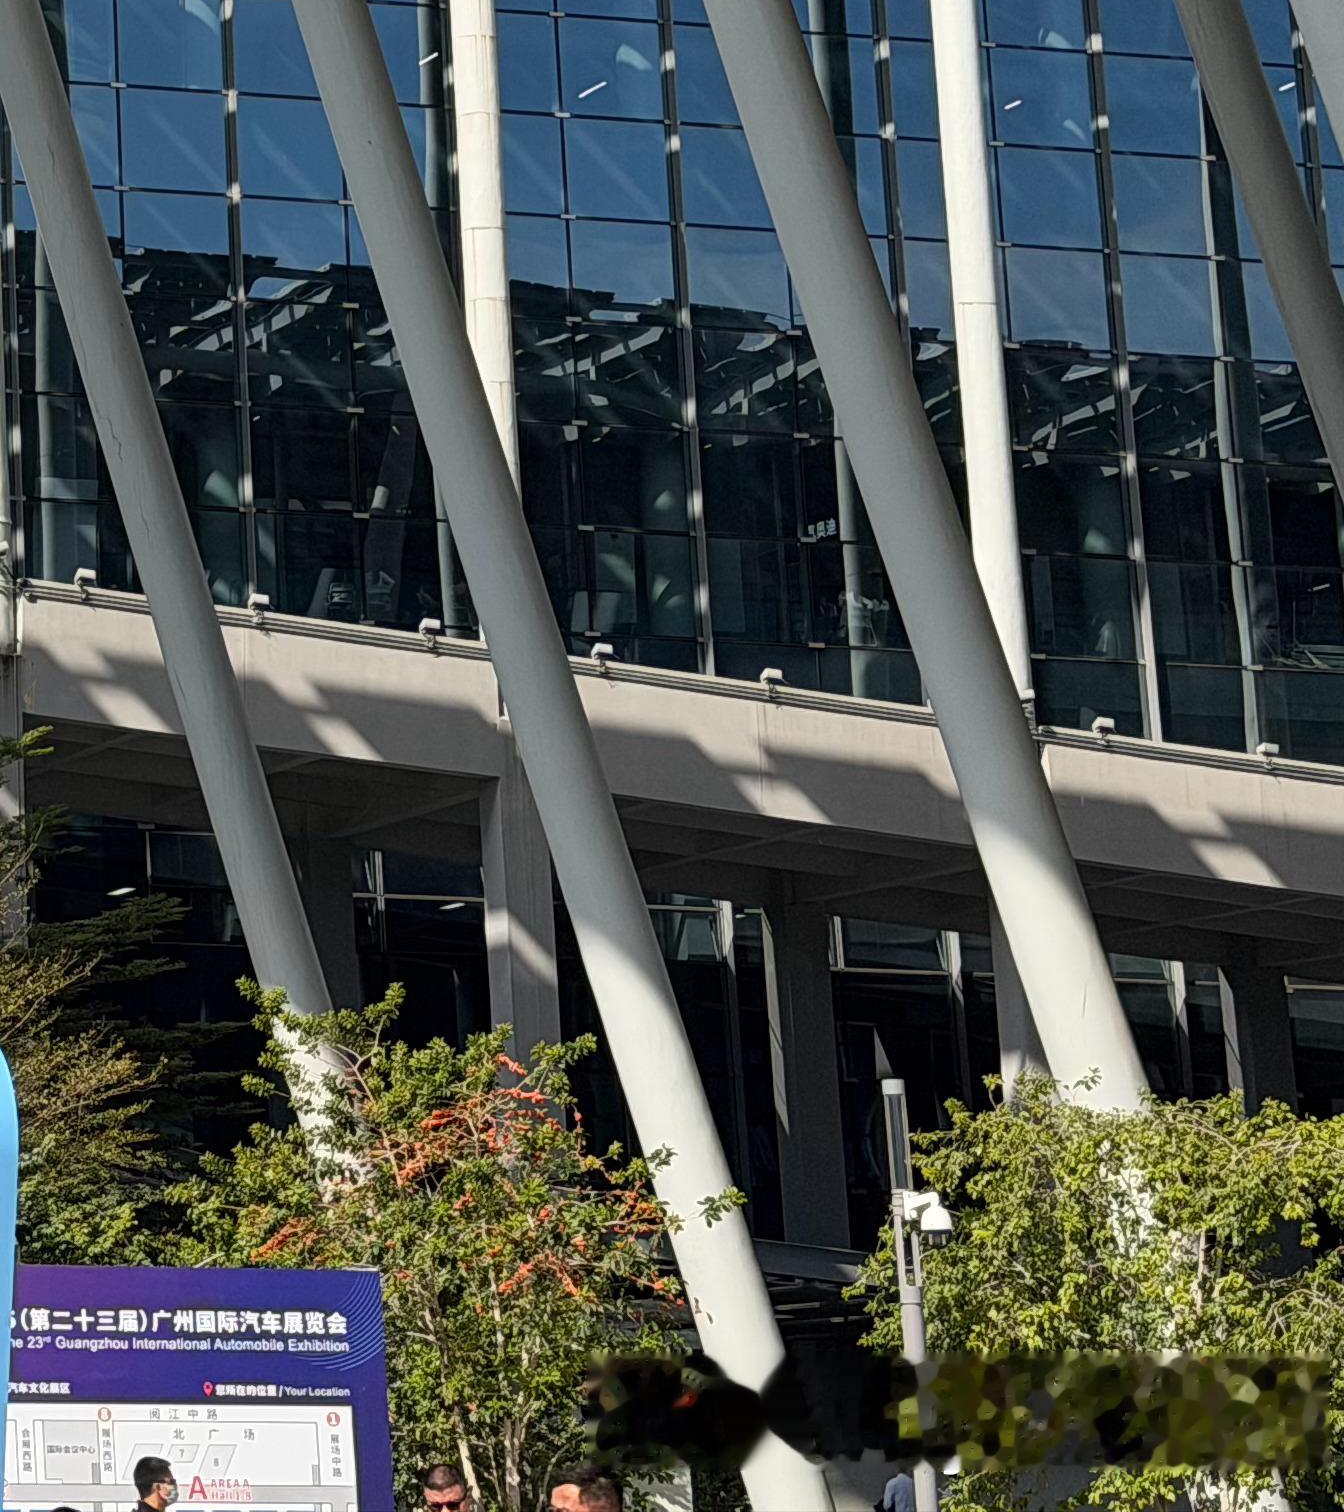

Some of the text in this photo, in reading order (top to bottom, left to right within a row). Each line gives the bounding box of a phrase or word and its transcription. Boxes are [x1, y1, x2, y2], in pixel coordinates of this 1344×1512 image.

[56, 1337, 129, 1352] Guangzhou
[133, 1338, 211, 1351] International
[214, 1338, 284, 1352] Automobile
[288, 1339, 350, 1353] Exhibition
[284, 1386, 308, 1397] Your
[309, 1386, 350, 1397] Location
[189, 1475, 207, 1500] A
